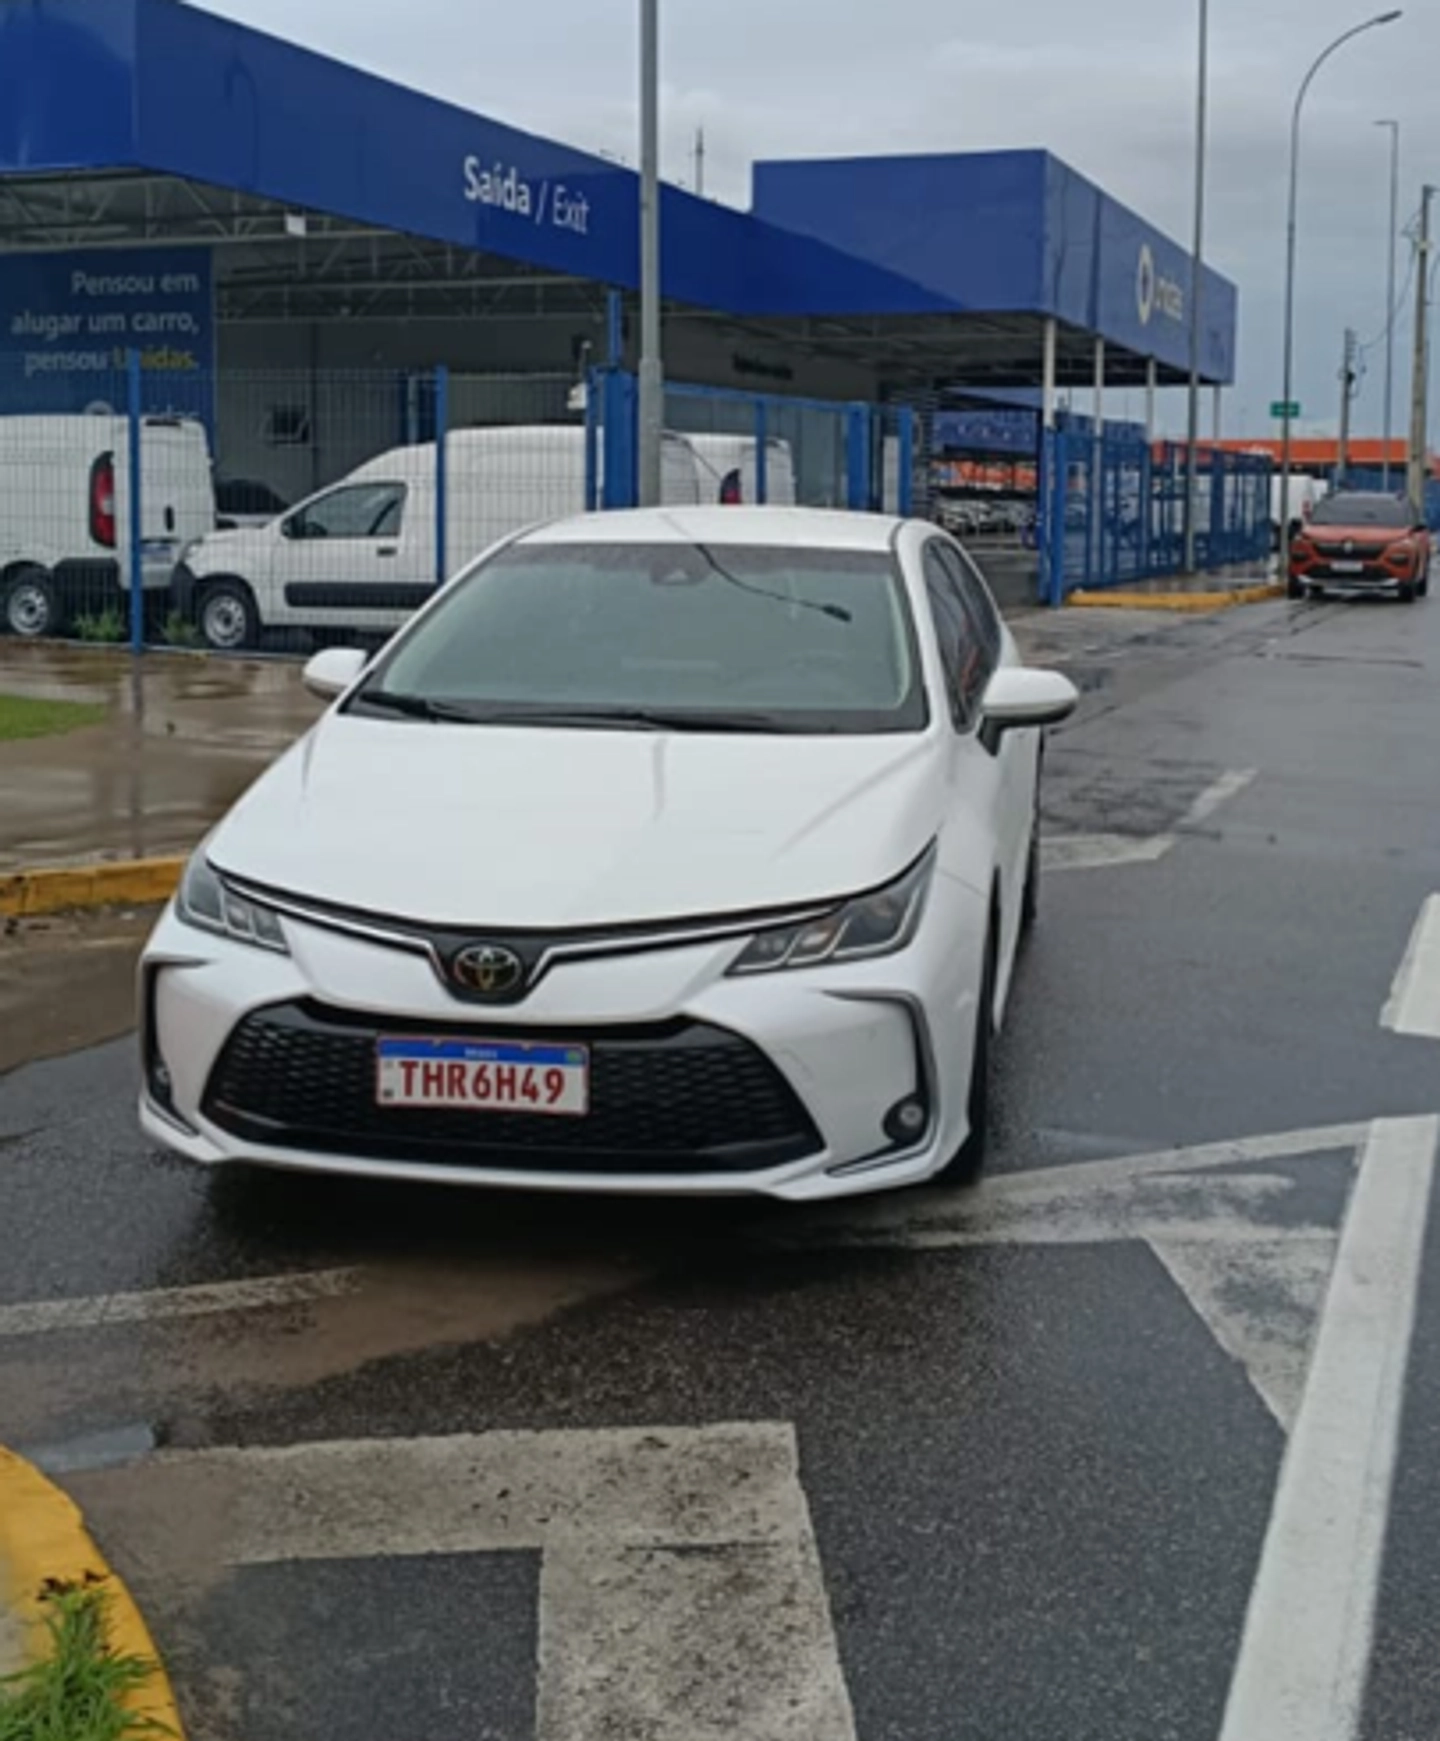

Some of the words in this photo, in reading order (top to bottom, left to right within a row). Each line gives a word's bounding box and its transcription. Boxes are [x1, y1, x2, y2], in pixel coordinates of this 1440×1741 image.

[464, 154, 532, 217] Saída
[534, 180, 548, 226] /
[553, 184, 590, 236] Exit
[71, 270, 155, 295] Pensou
[160, 272, 200, 293] em
[11, 309, 81, 341] alugar
[88, 313, 126, 334] um
[131, 311, 200, 335] carro,
[25, 350, 108, 378] pensou
[399, 1060, 565, 1104] THR6H49
